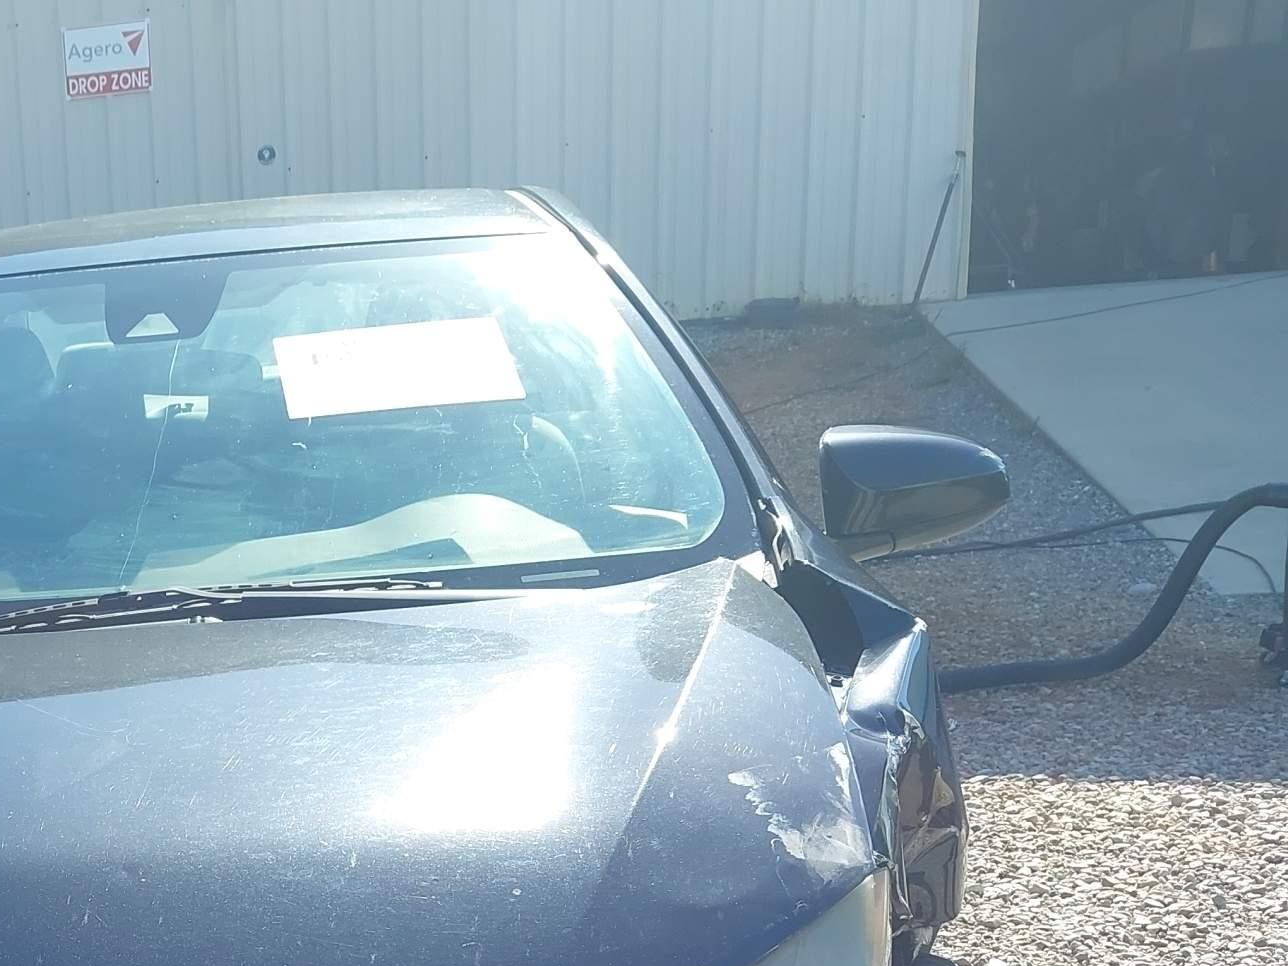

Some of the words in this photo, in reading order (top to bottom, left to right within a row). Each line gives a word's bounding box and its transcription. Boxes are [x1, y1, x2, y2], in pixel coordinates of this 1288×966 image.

[68, 43, 123, 62] Agero
[69, 75, 107, 95] DROP
[111, 70, 149, 90] ZONE
